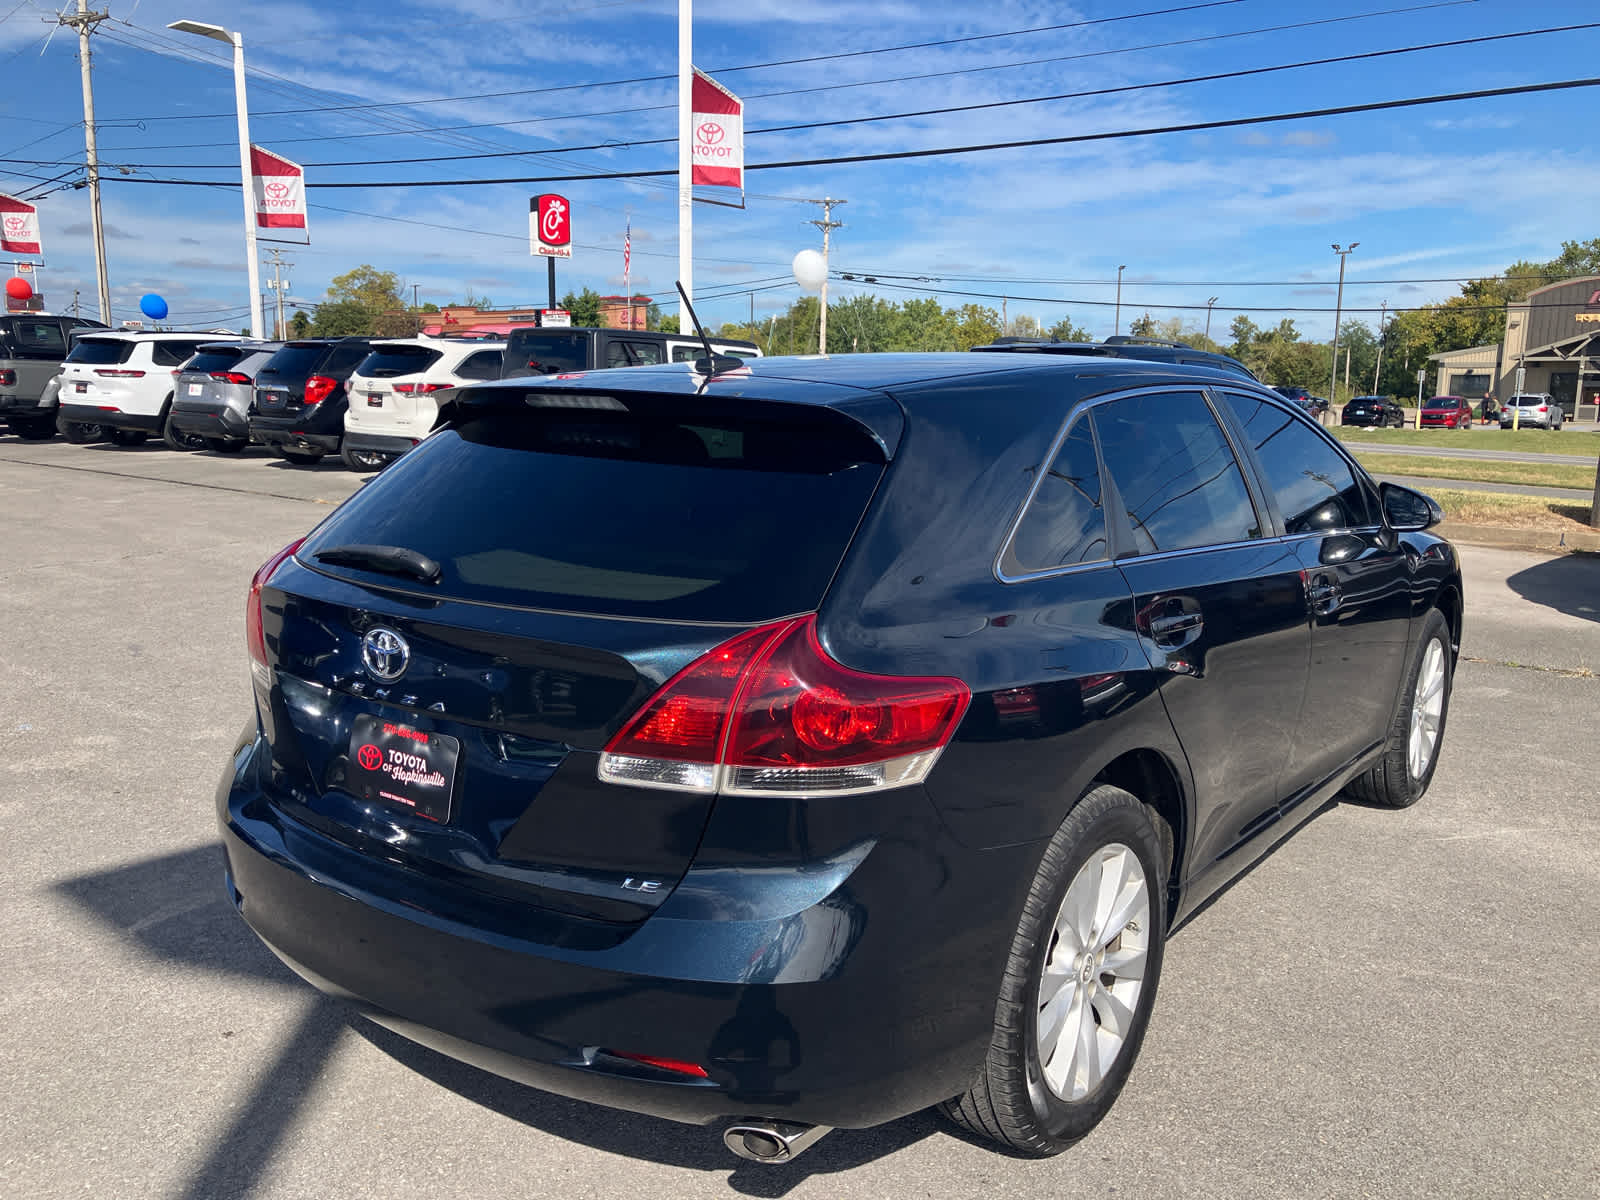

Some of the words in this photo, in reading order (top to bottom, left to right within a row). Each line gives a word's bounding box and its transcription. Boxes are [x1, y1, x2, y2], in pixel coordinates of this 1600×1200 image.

[388, 749, 428, 773] TOYOTA
[391, 765, 446, 788] Hopkinsville
[620, 878, 662, 893] LE
